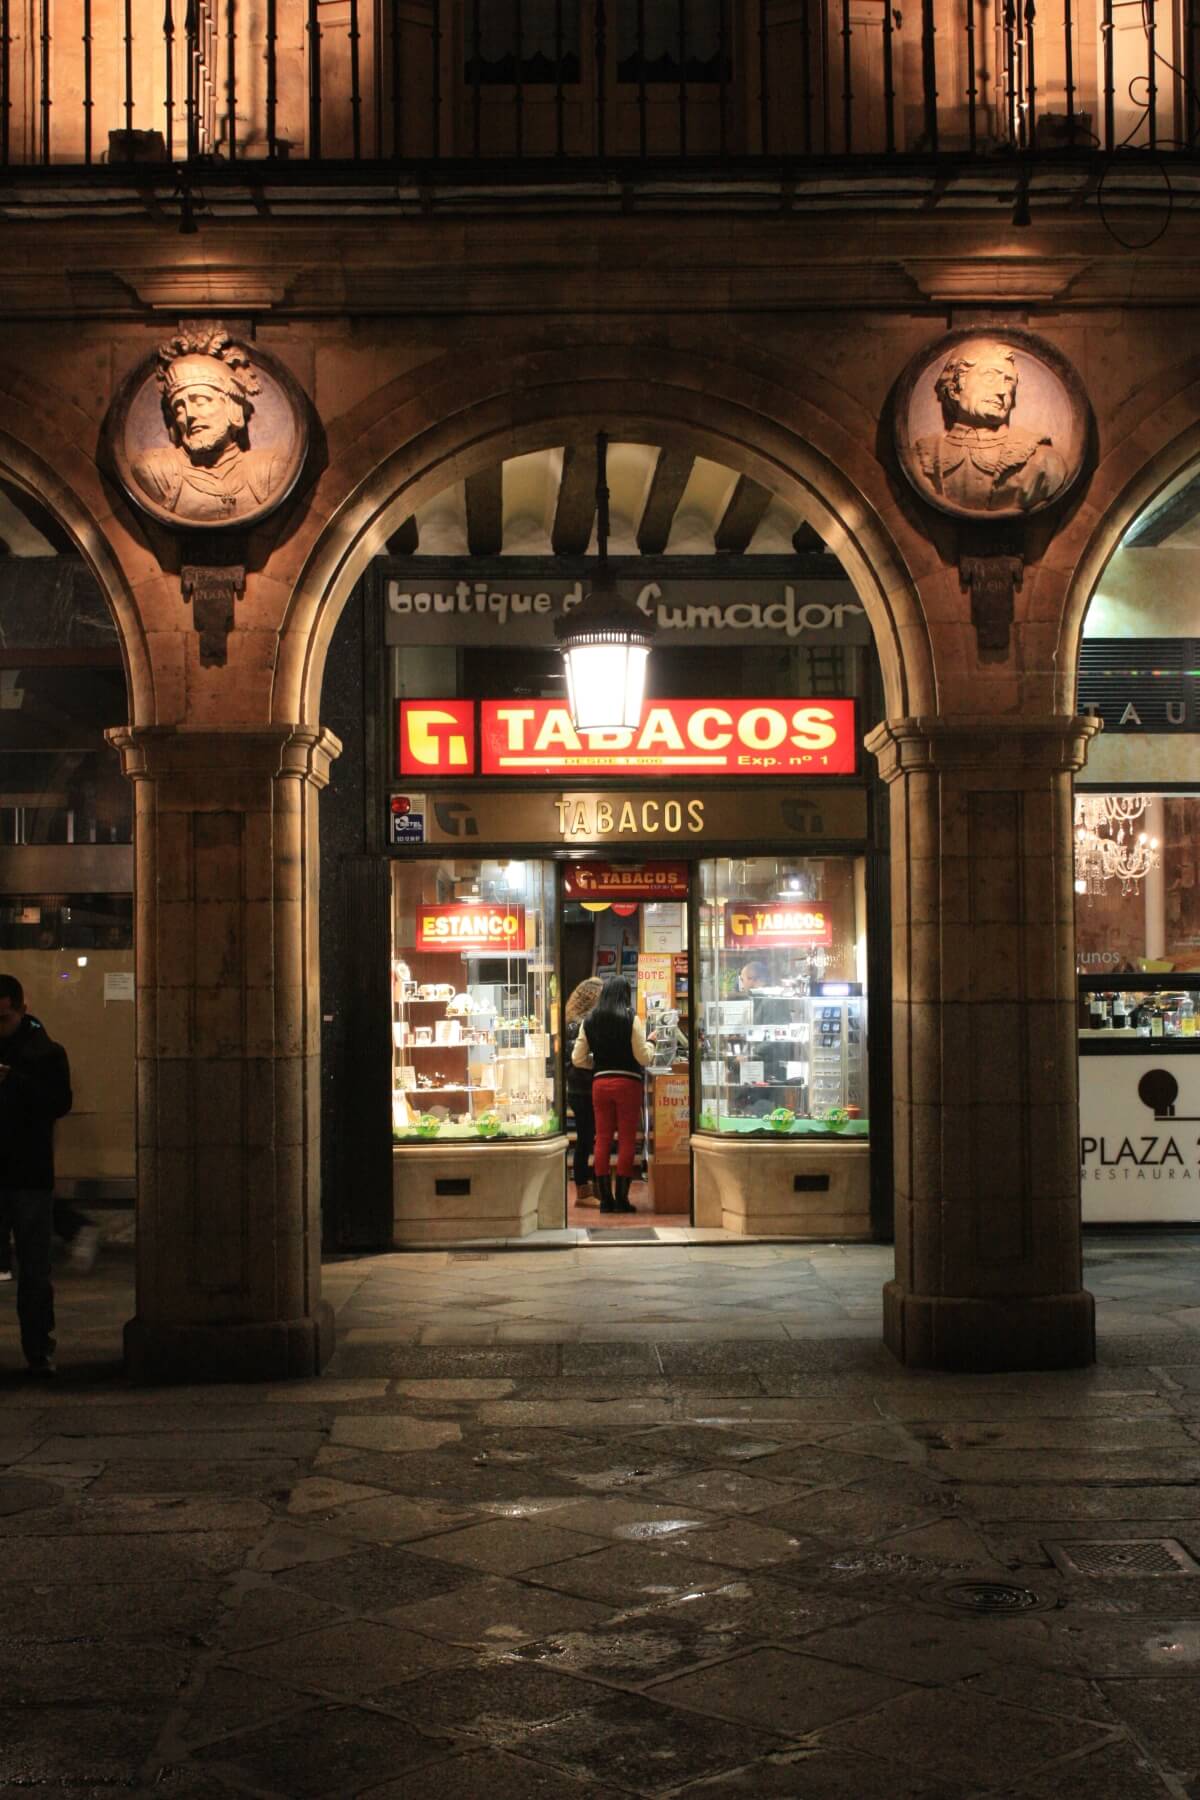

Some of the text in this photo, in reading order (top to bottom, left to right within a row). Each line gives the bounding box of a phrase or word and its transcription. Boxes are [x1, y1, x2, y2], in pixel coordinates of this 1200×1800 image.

[388, 580, 552, 625] boutique
[737, 754, 782, 767] Exp.
[820, 755, 828, 765] 1
[554, 799, 705, 834] TABACOS
[601, 872, 679, 884] TABACOS
[422, 915, 518, 935] ESTANCO
[755, 912, 825, 929] TABACOS
[1080, 1136, 1184, 1165] PLAZA
[1080, 1168, 1200, 1180] RESTAURA
